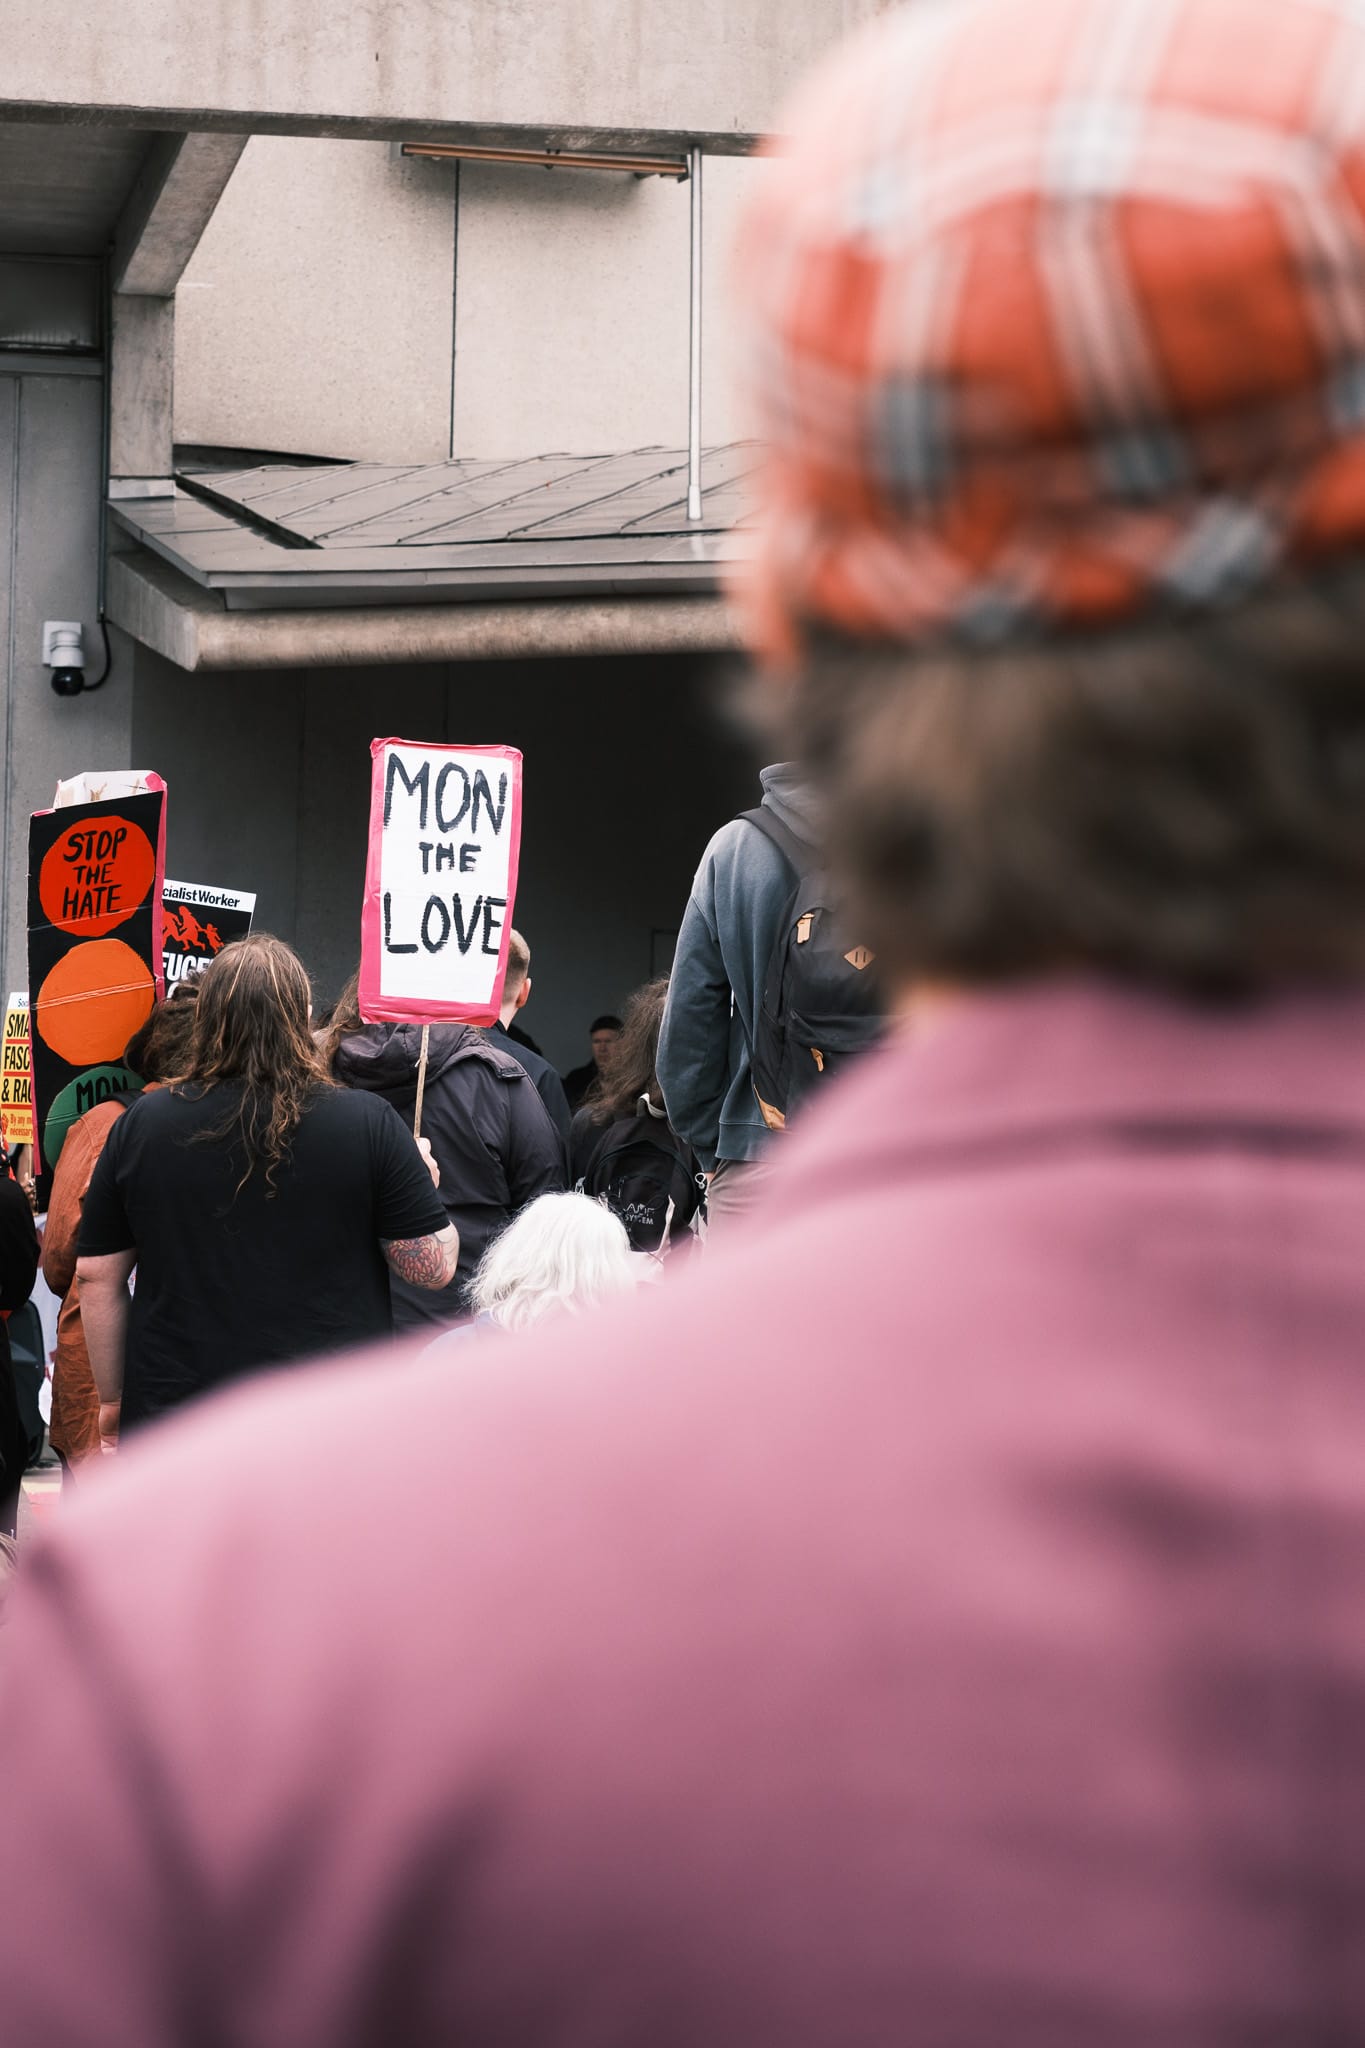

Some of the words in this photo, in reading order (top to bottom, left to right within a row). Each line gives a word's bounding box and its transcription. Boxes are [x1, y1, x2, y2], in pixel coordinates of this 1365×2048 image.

[384, 753, 508, 836] MON
[63, 827, 128, 862] STOP
[419, 841, 482, 875] THE
[72, 862, 114, 886] THE
[62, 884, 122, 920] HATE
[199, 889, 241, 908] Worker
[384, 891, 507, 955] LOVE
[4, 1045, 30, 1071] FASC
[1, 1078, 10, 1102] &
